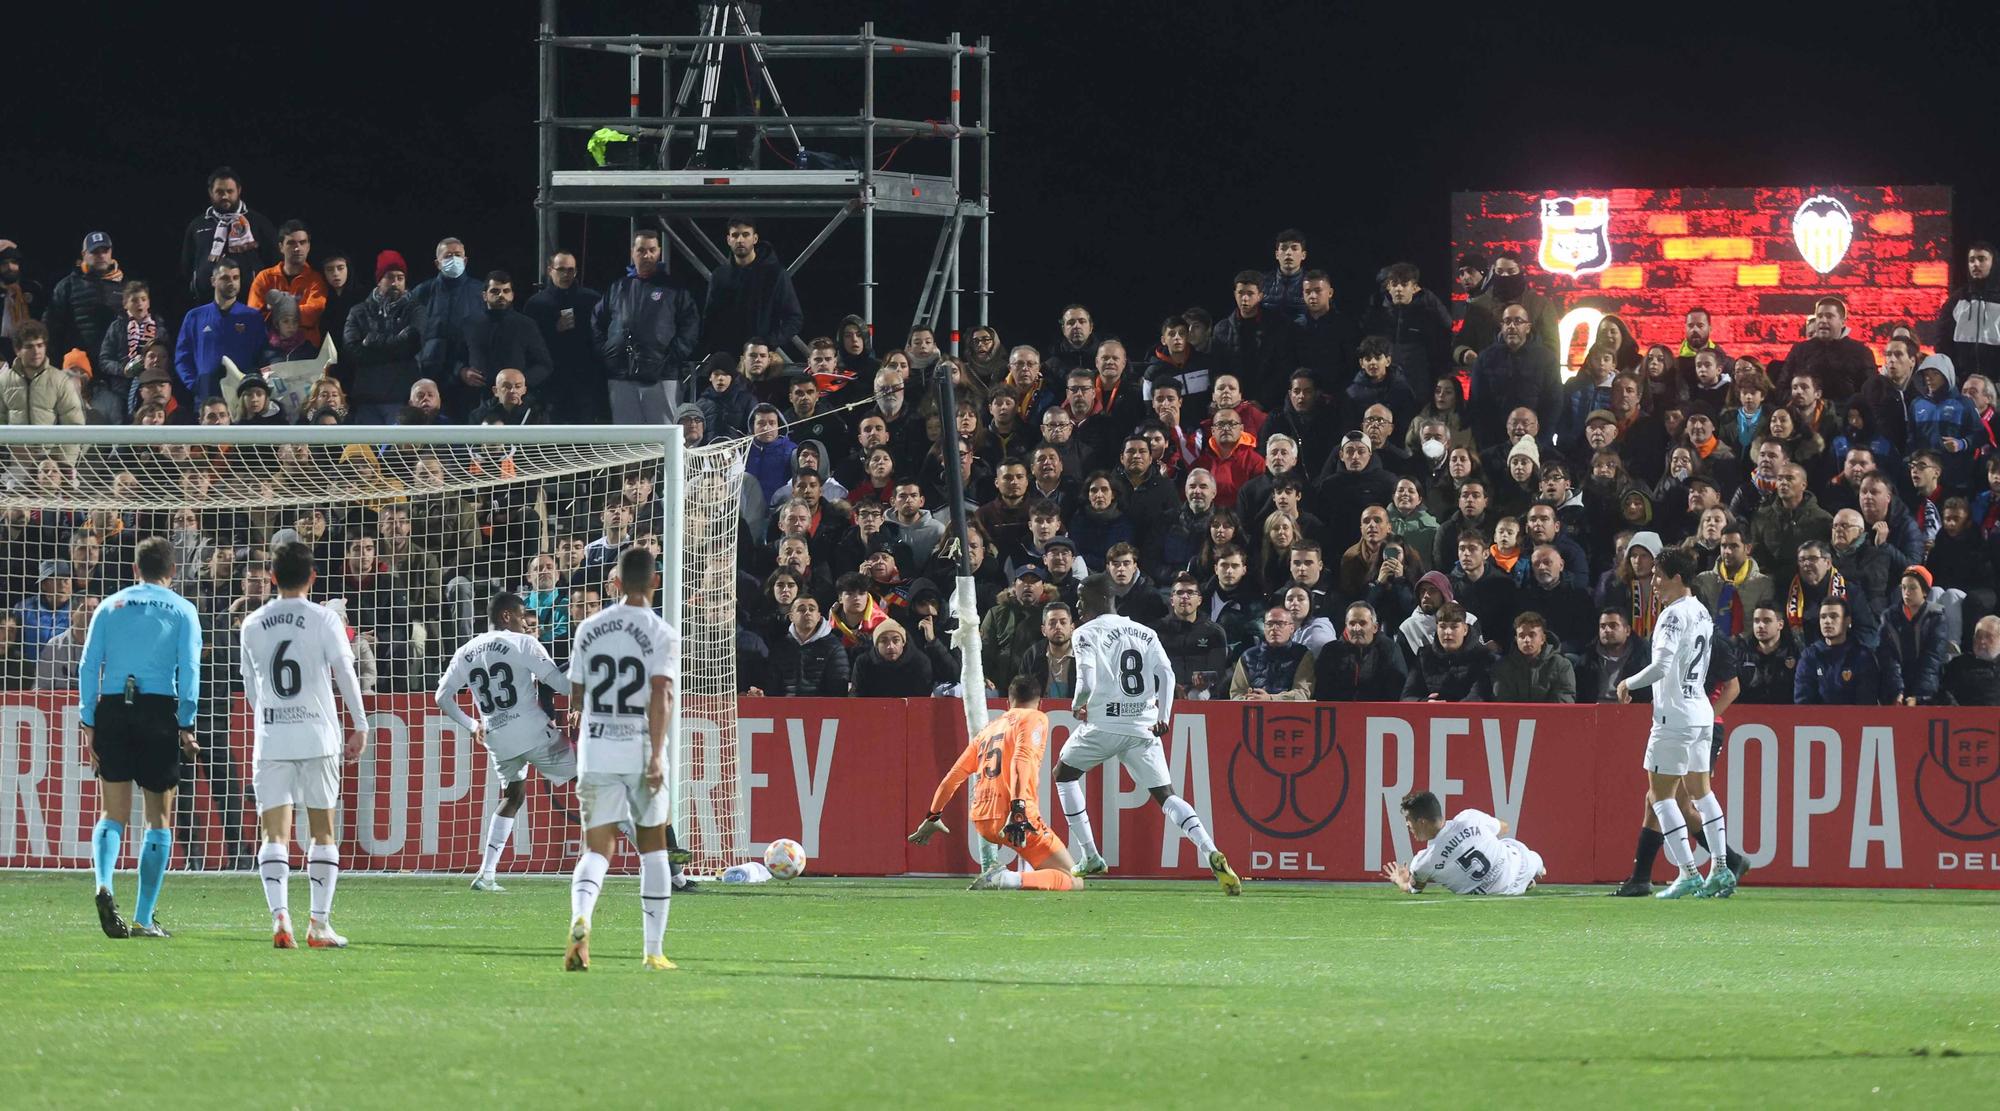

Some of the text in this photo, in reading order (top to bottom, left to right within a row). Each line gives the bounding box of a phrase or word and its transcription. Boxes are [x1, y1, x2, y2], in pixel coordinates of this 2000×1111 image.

[261, 613, 306, 630] HUGO G.
[580, 619, 624, 652] MARCOS
[1103, 627, 1121, 649] ILAIX
[269, 639, 302, 700] 6
[469, 661, 518, 717] 33
[588, 654, 646, 718] 22
[1119, 648, 1146, 698] 8
[678, 717, 839, 859] REY
[1251, 851, 1326, 871] DEL
[1434, 826, 1481, 870] G. PAULISTA
[1456, 846, 1491, 881] 5
[1938, 852, 2000, 870] DEL
